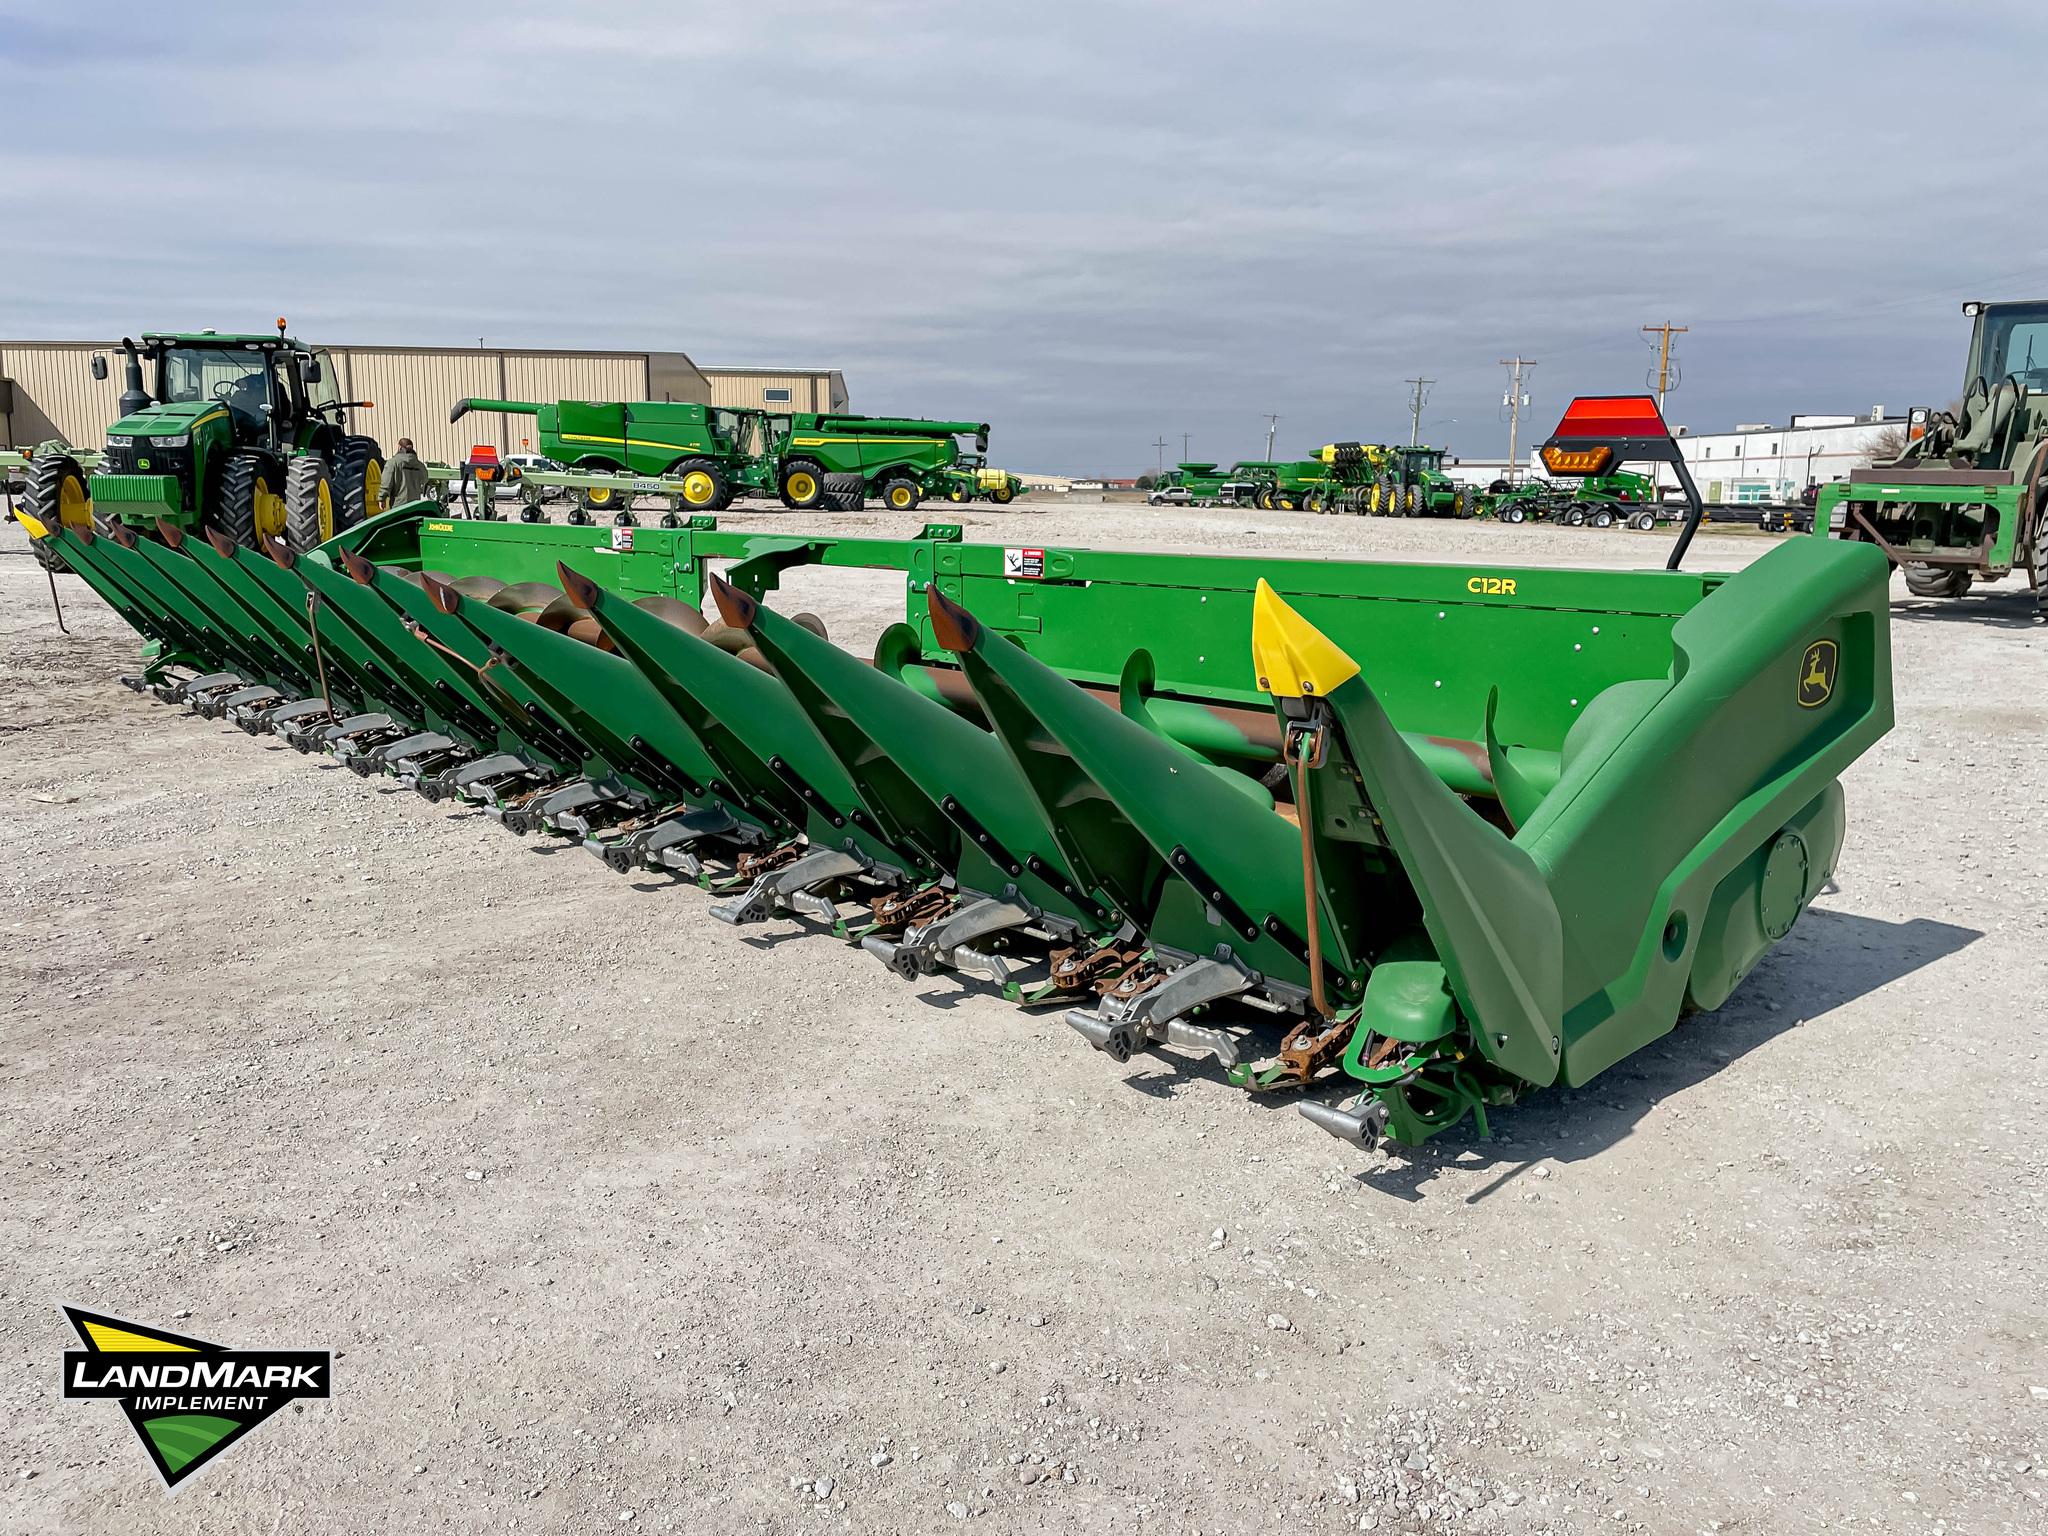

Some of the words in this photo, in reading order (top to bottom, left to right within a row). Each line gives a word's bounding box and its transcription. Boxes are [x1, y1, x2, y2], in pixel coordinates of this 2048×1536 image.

[428, 522, 440, 531] JOHN
[440, 522, 454, 532] DEERE
[1467, 577, 1517, 596] C12R
